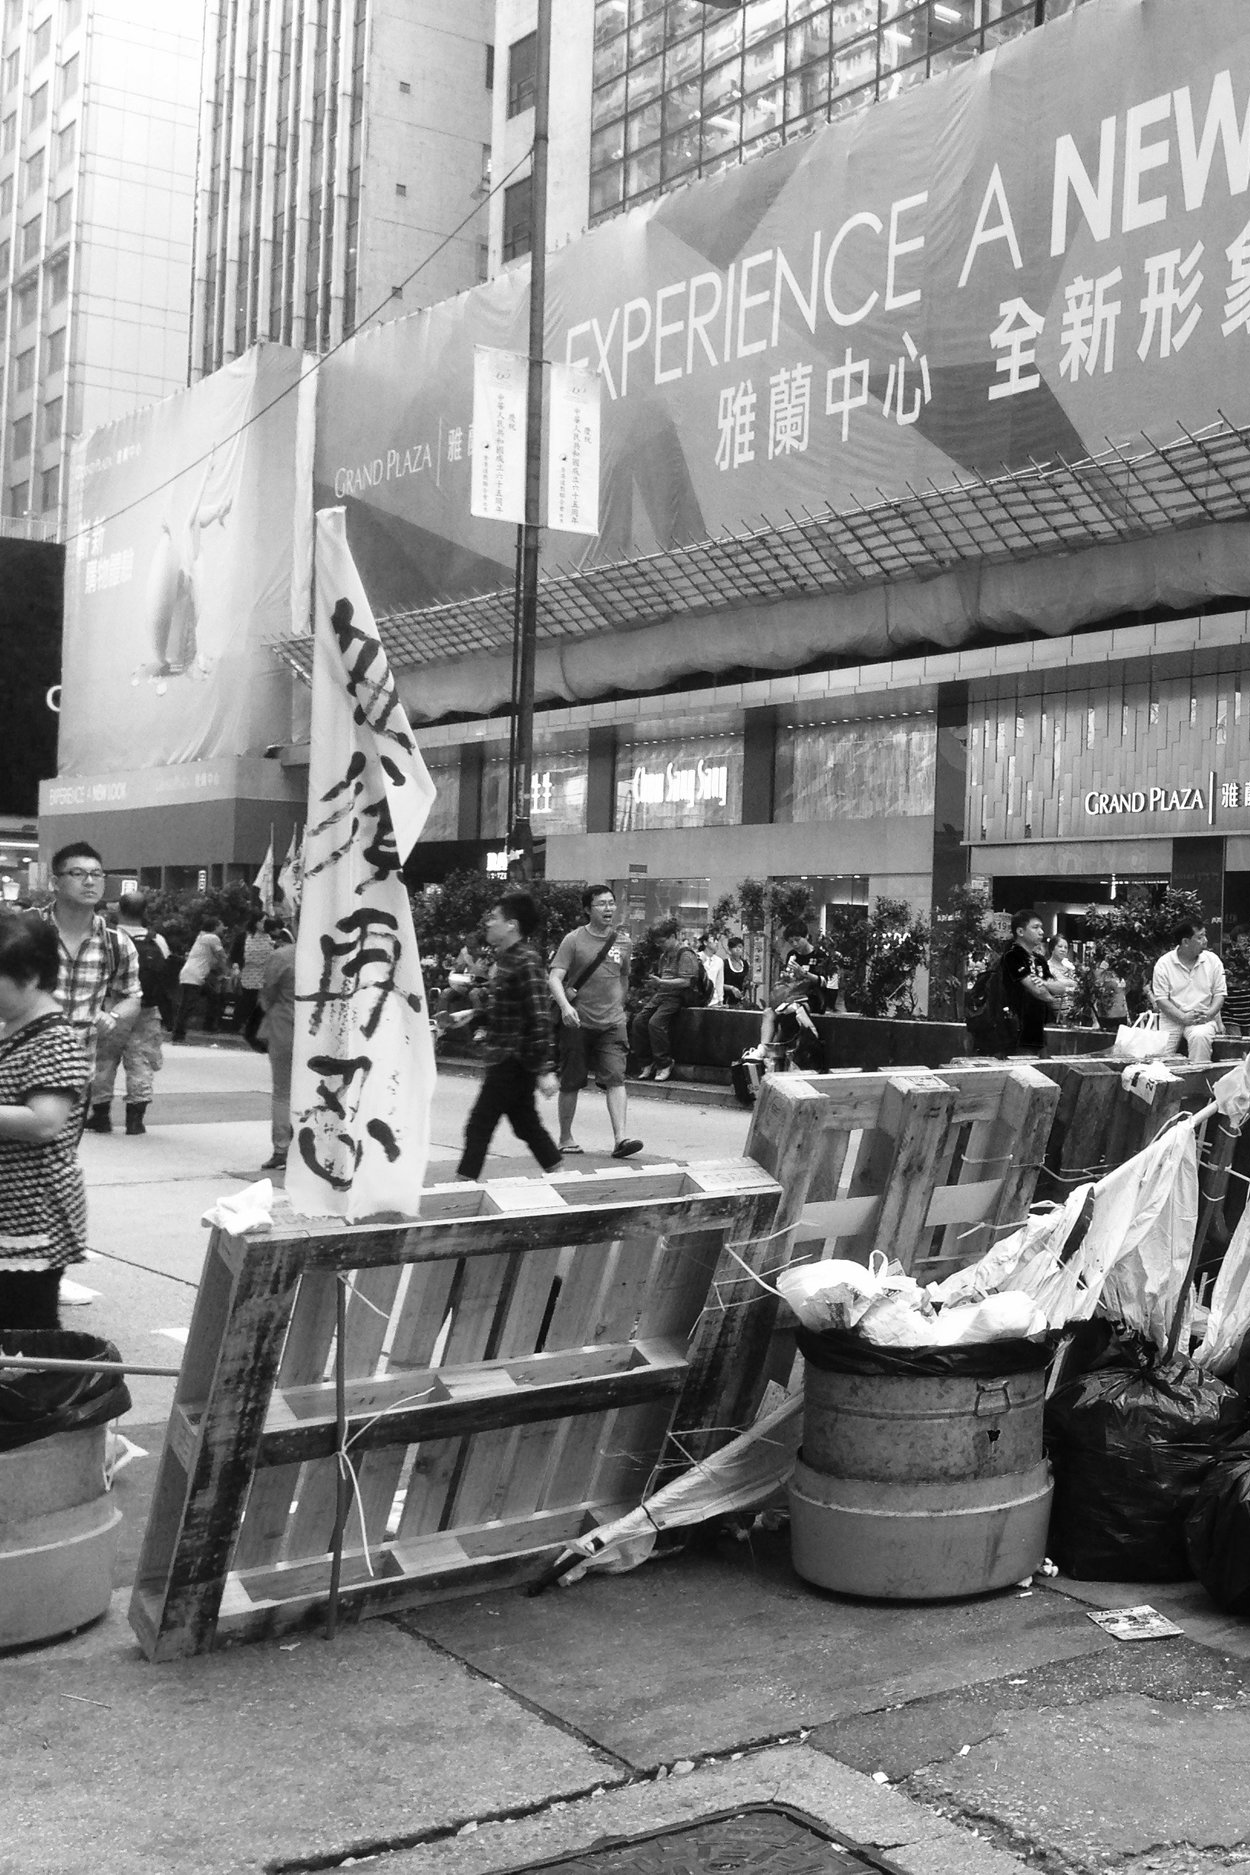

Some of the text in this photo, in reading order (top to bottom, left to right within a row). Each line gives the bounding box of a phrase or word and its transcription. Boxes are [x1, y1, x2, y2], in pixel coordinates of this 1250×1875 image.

[566, 191, 928, 400] EXPERIENCE
[957, 162, 1023, 288] A
[714, 331, 932, 471] 雅蘭中心
[335, 443, 432, 498] GRAND PLAZA
[1085, 787, 1204, 816] GRAND PLAZA
